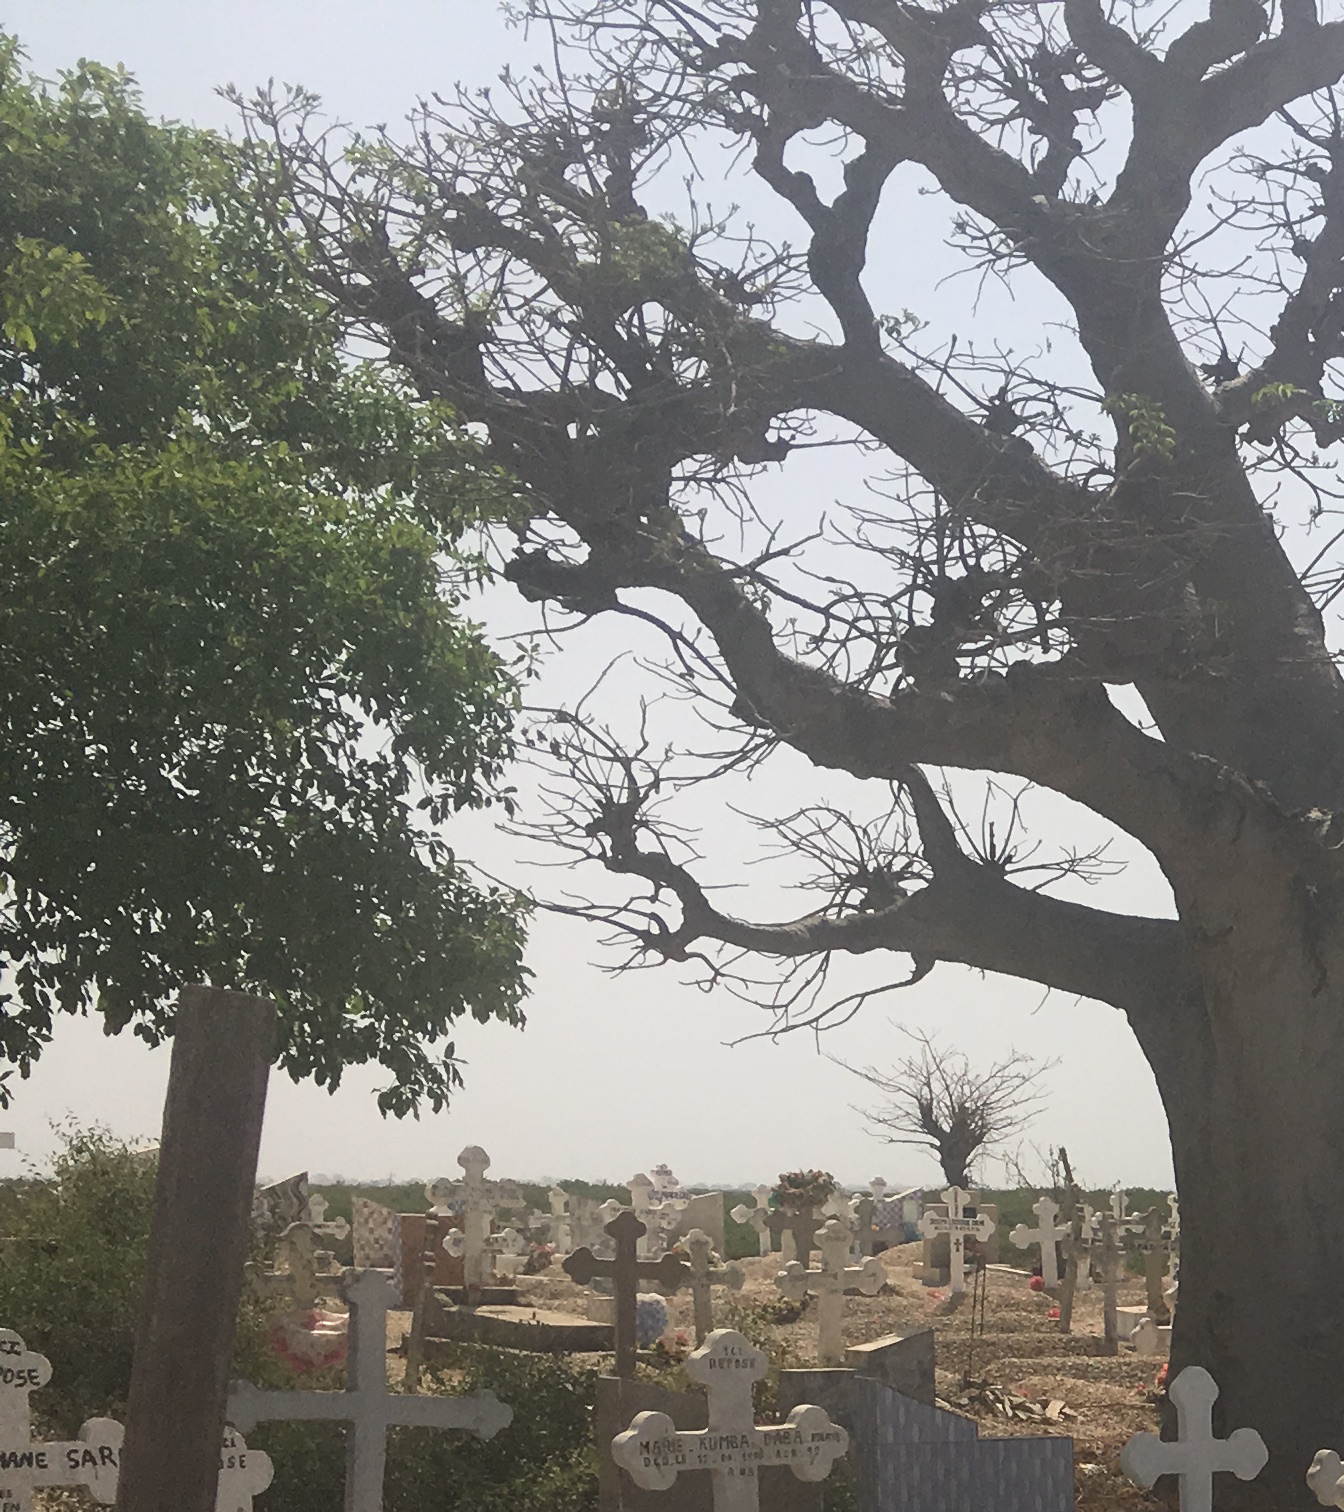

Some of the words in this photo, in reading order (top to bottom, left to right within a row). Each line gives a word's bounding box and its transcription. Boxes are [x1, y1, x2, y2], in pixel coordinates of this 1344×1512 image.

[0, 1340, 21, 1355] CI
[709, 1358, 755, 1370] REPOSE
[0, 1367, 40, 1388] OSE
[699, 1435, 750, 1451] KUMBA
[66, 1445, 122, 1469] SAR
